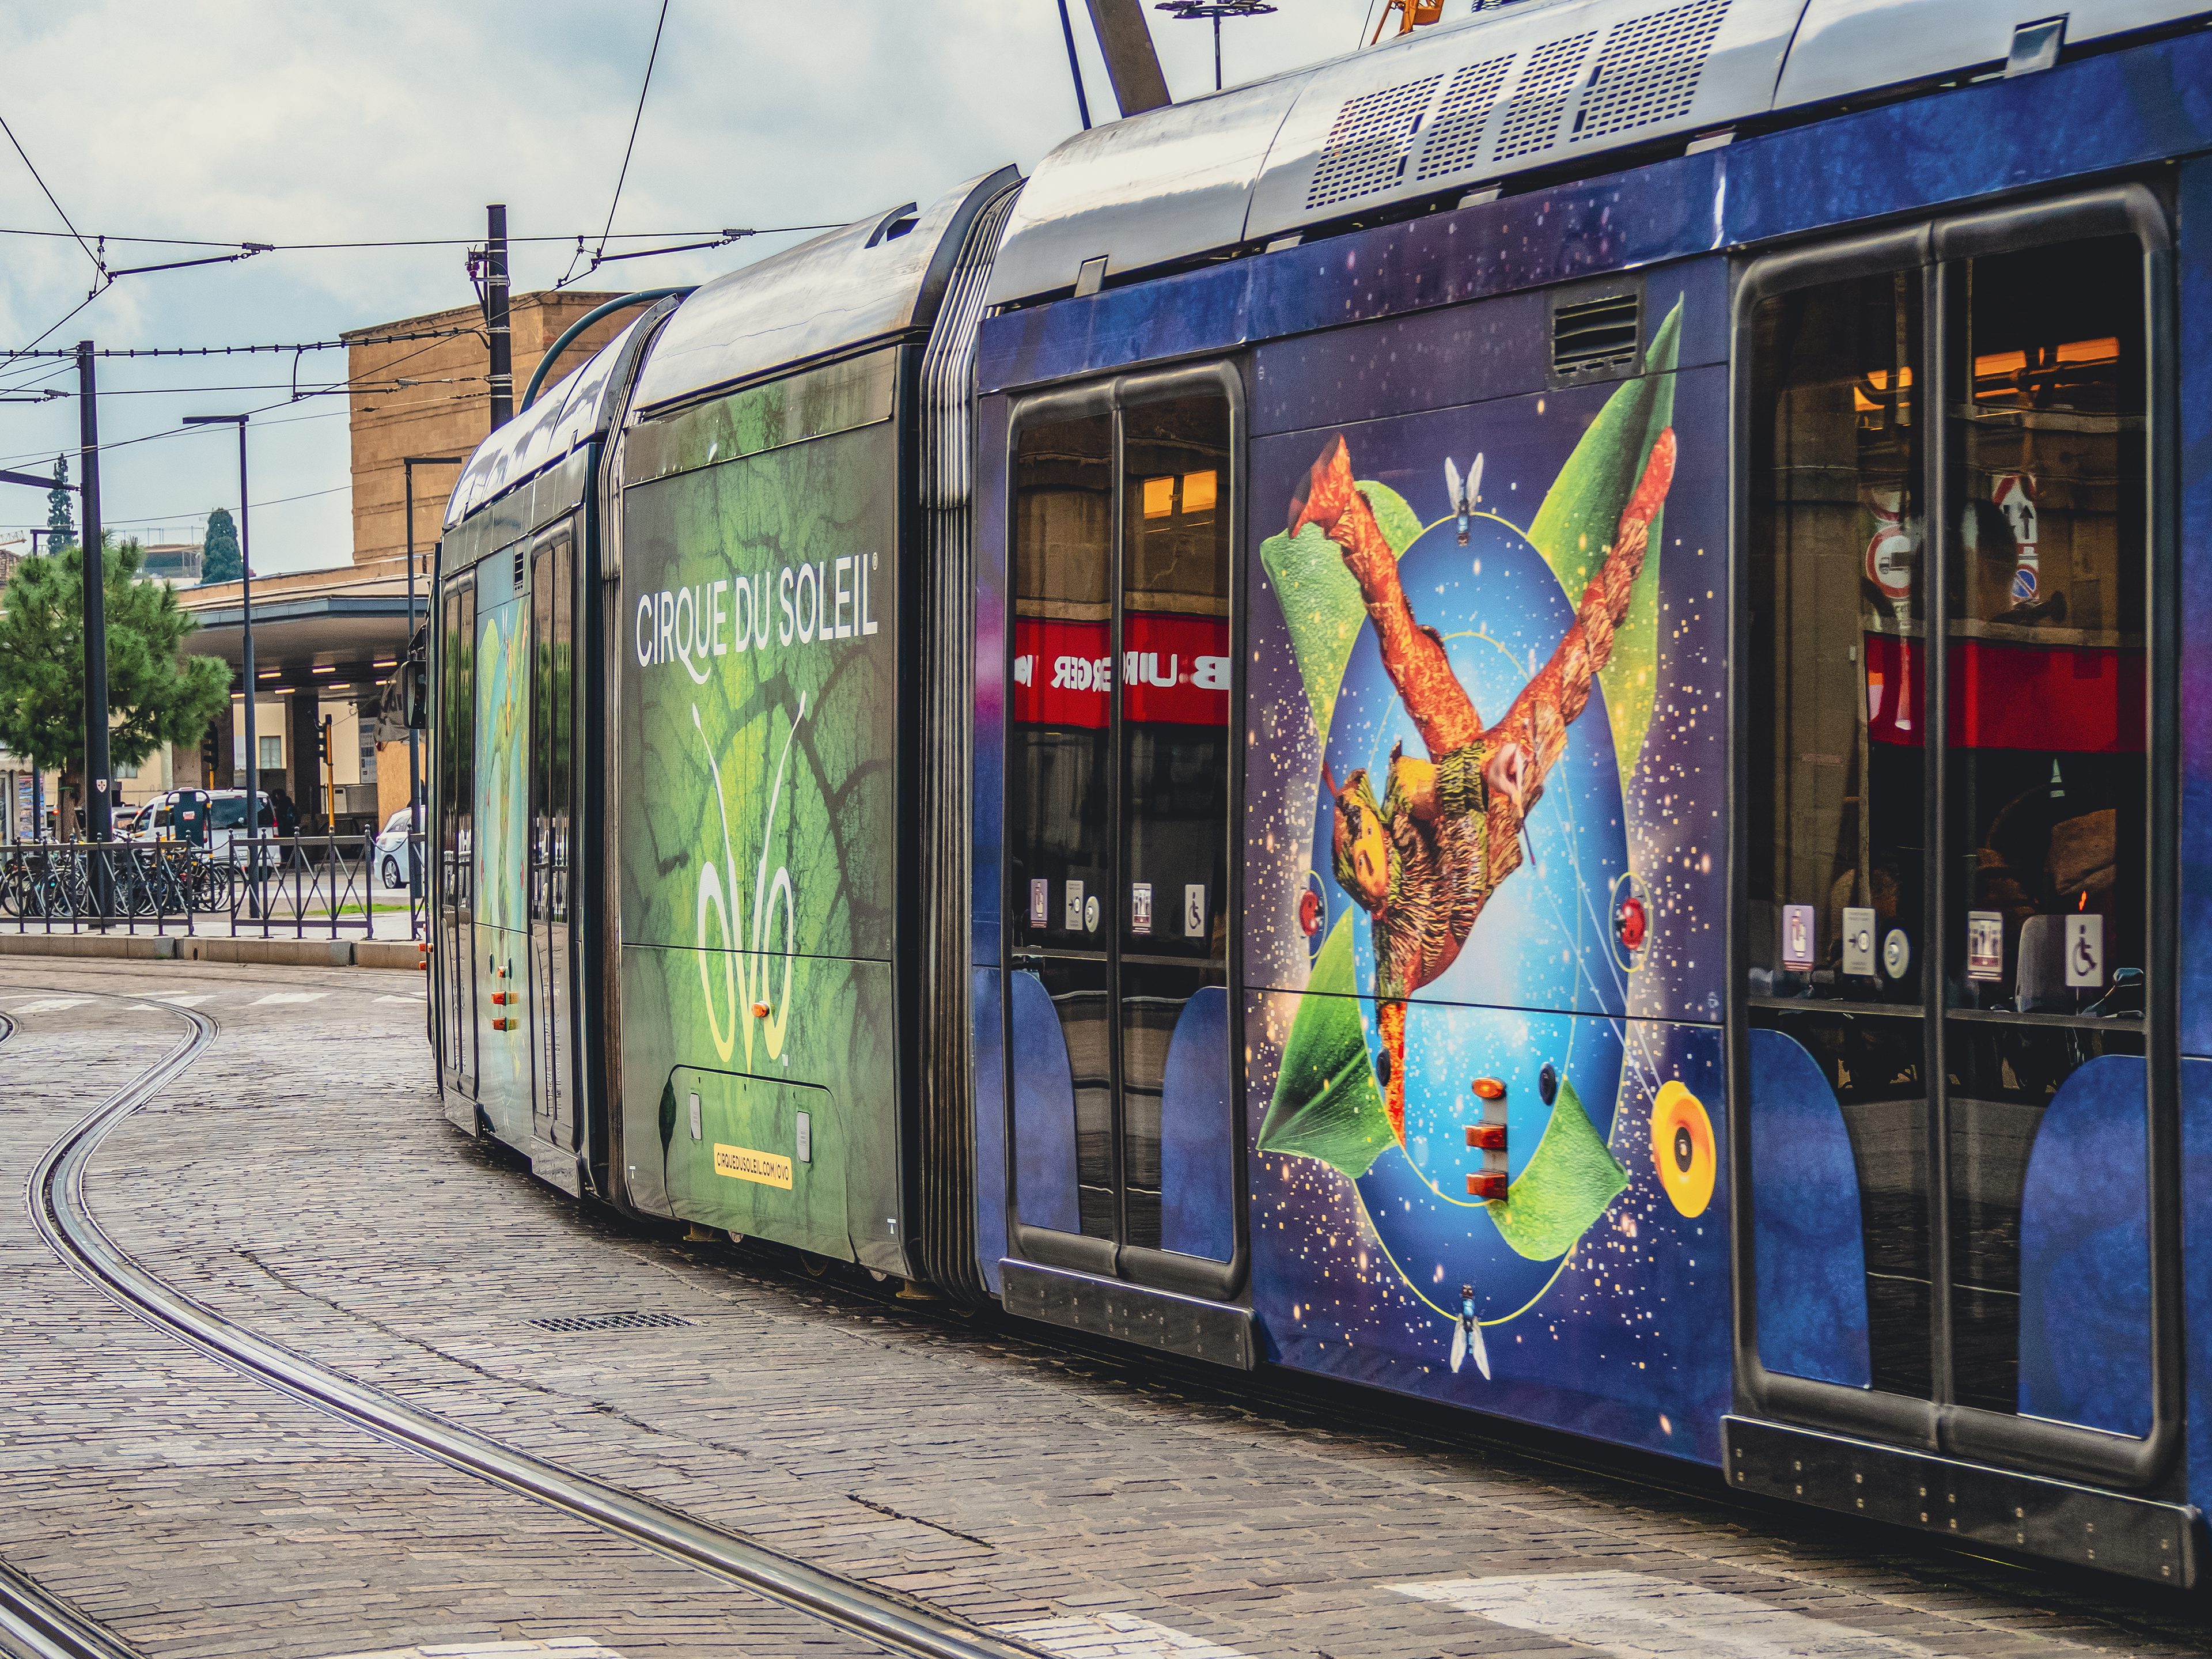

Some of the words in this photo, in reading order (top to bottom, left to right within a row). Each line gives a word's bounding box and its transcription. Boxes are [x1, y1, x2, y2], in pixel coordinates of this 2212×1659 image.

[637, 580, 727, 685] CIRQUE
[736, 571, 770, 653] DU
[717, 1152, 789, 1181] CIRQUEDUSOLEIL.COM/OVO
